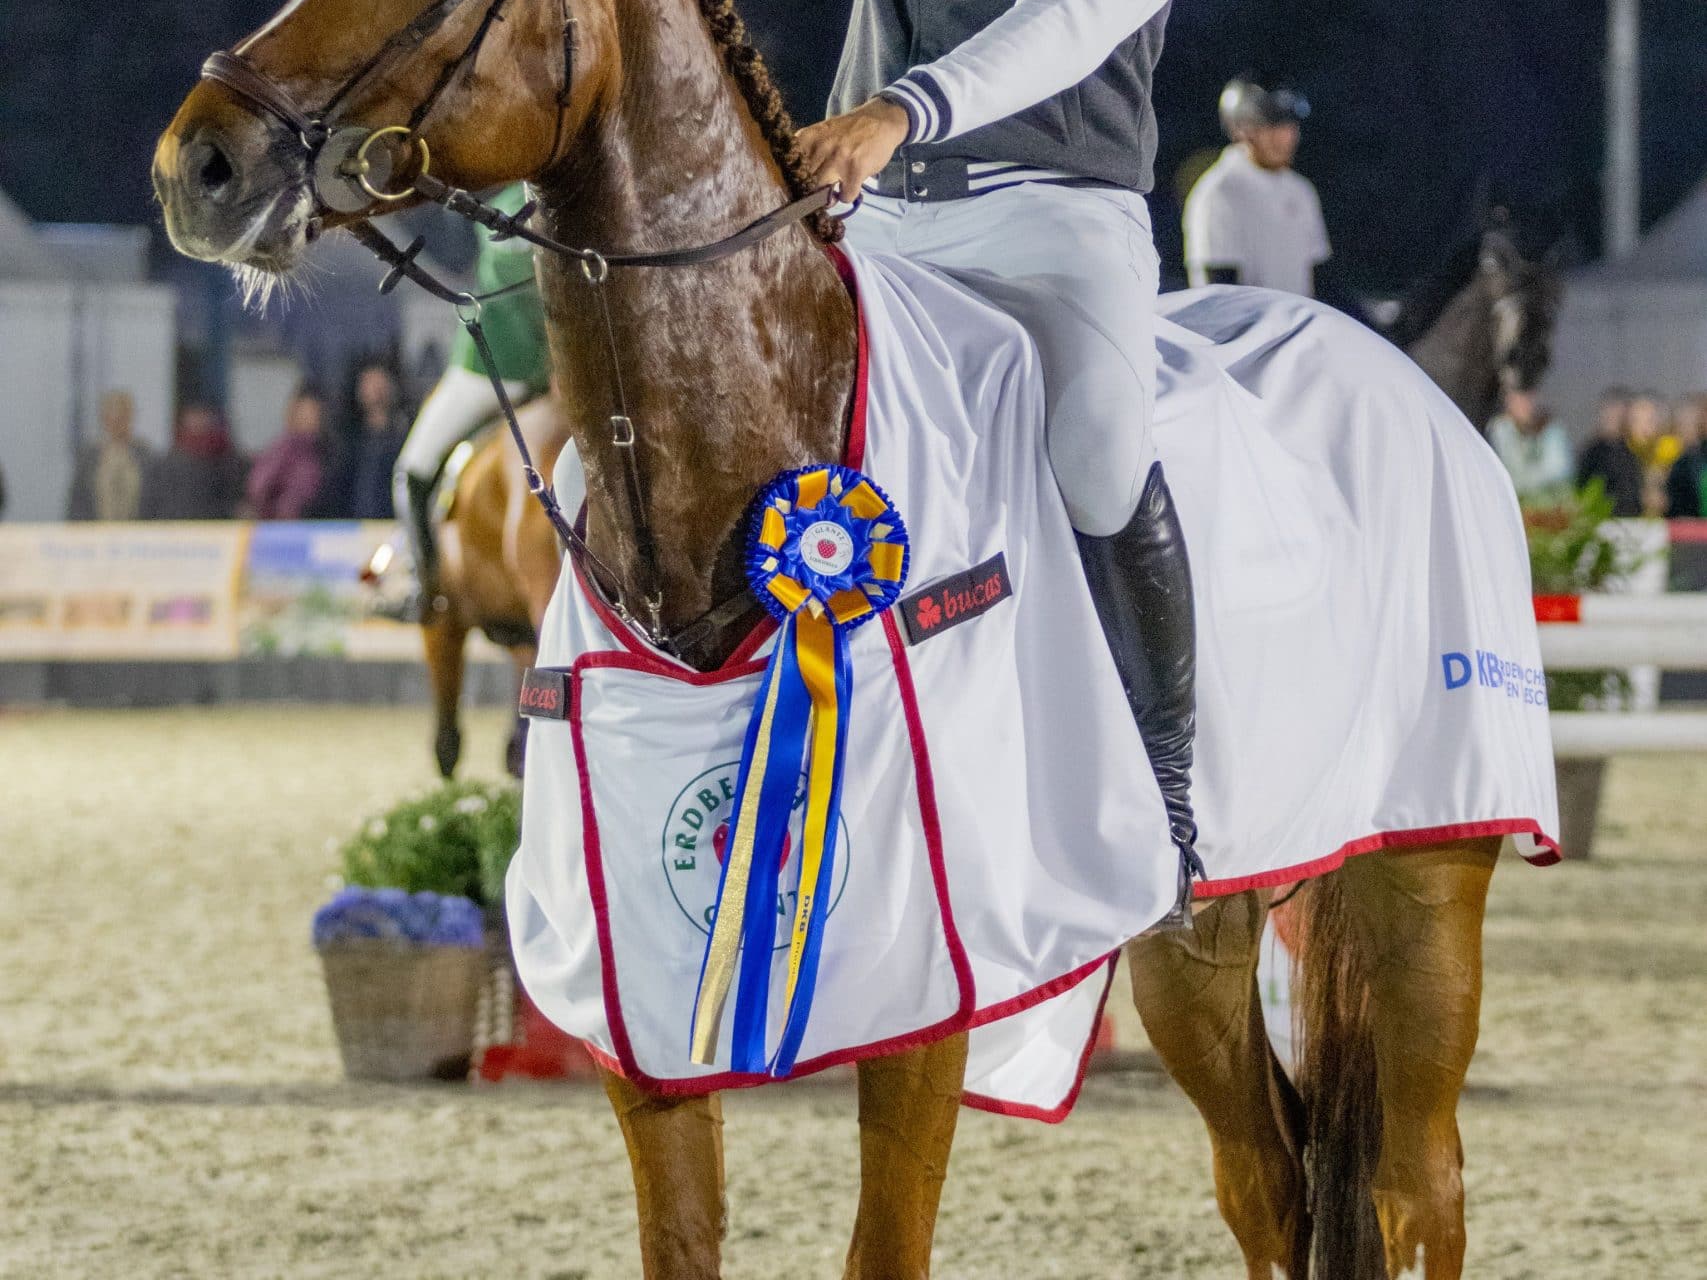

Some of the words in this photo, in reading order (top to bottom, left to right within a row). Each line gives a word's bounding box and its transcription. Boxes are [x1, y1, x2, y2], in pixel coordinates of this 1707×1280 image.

[942, 572, 1001, 619] bucas
[1441, 649, 1504, 691] DKB
[521, 687, 558, 710] ucas
